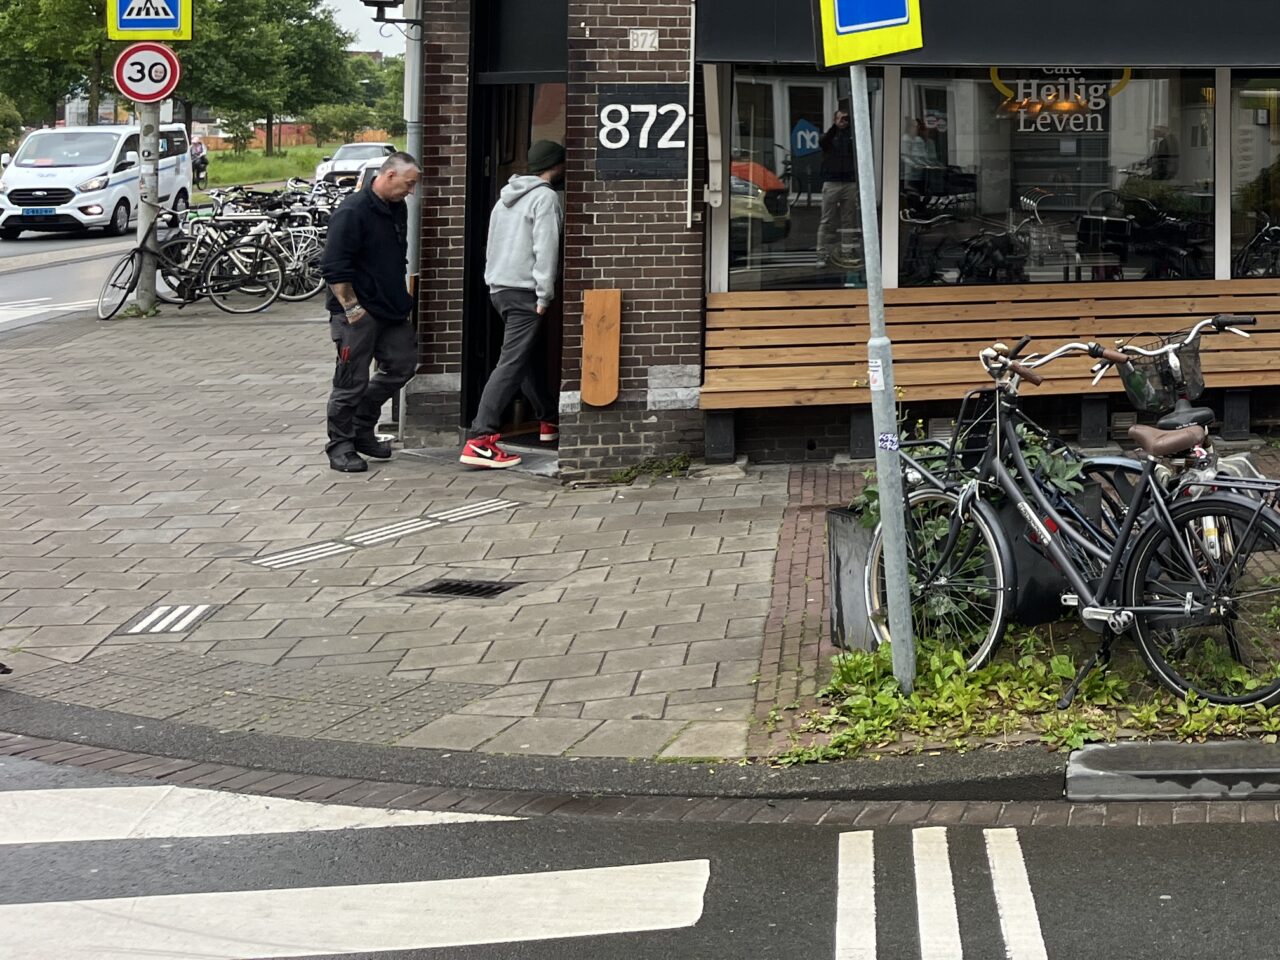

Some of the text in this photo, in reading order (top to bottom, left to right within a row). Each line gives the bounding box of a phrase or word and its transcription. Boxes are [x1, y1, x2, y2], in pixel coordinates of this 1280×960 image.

[631, 32, 658, 49] 872
[127, 61, 168, 84] 30
[1016, 76, 1107, 110] Heilig
[598, 103, 687, 149] 872
[1017, 108, 1105, 132] Leven
